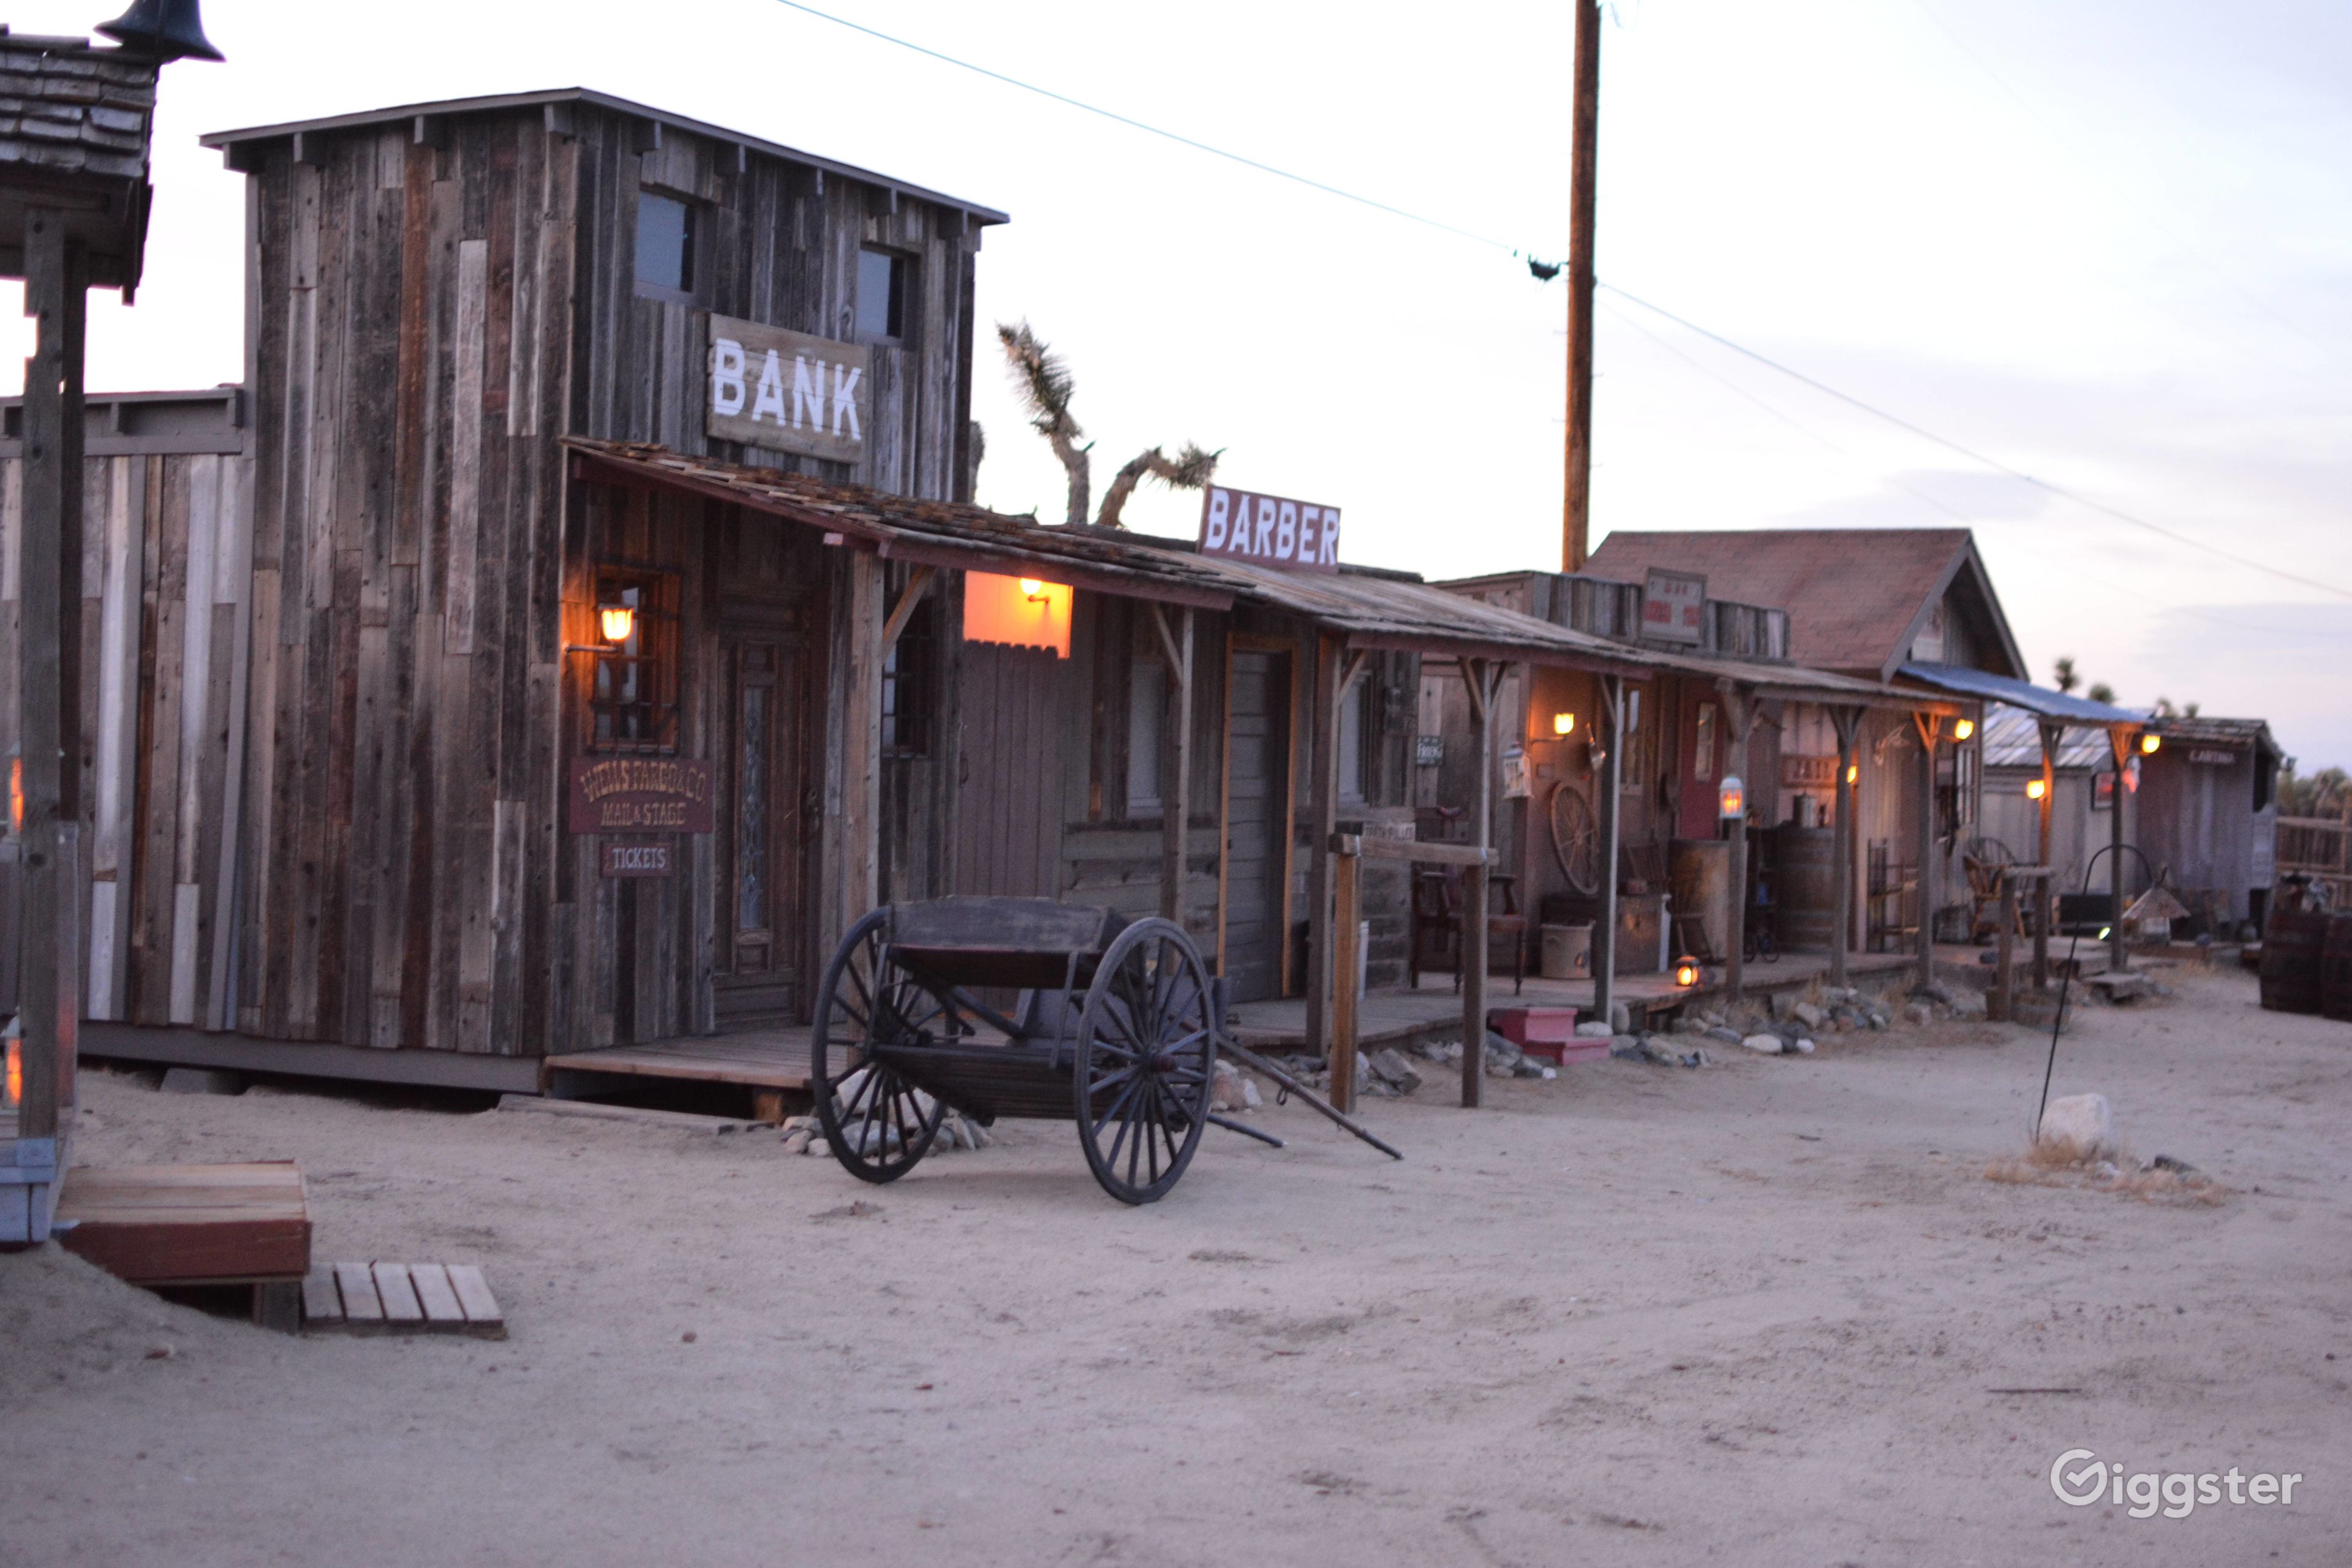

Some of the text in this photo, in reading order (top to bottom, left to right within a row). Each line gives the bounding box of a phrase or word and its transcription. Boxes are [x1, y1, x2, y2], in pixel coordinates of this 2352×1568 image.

[714, 337, 862, 440] BANK
[1204, 489, 1339, 567] BARBER
[579, 760, 630, 804] WELLS
[631, 761, 677, 794] FARGO
[601, 802, 687, 826] MAIL & STAGE
[612, 847, 666, 870] TICKETS
